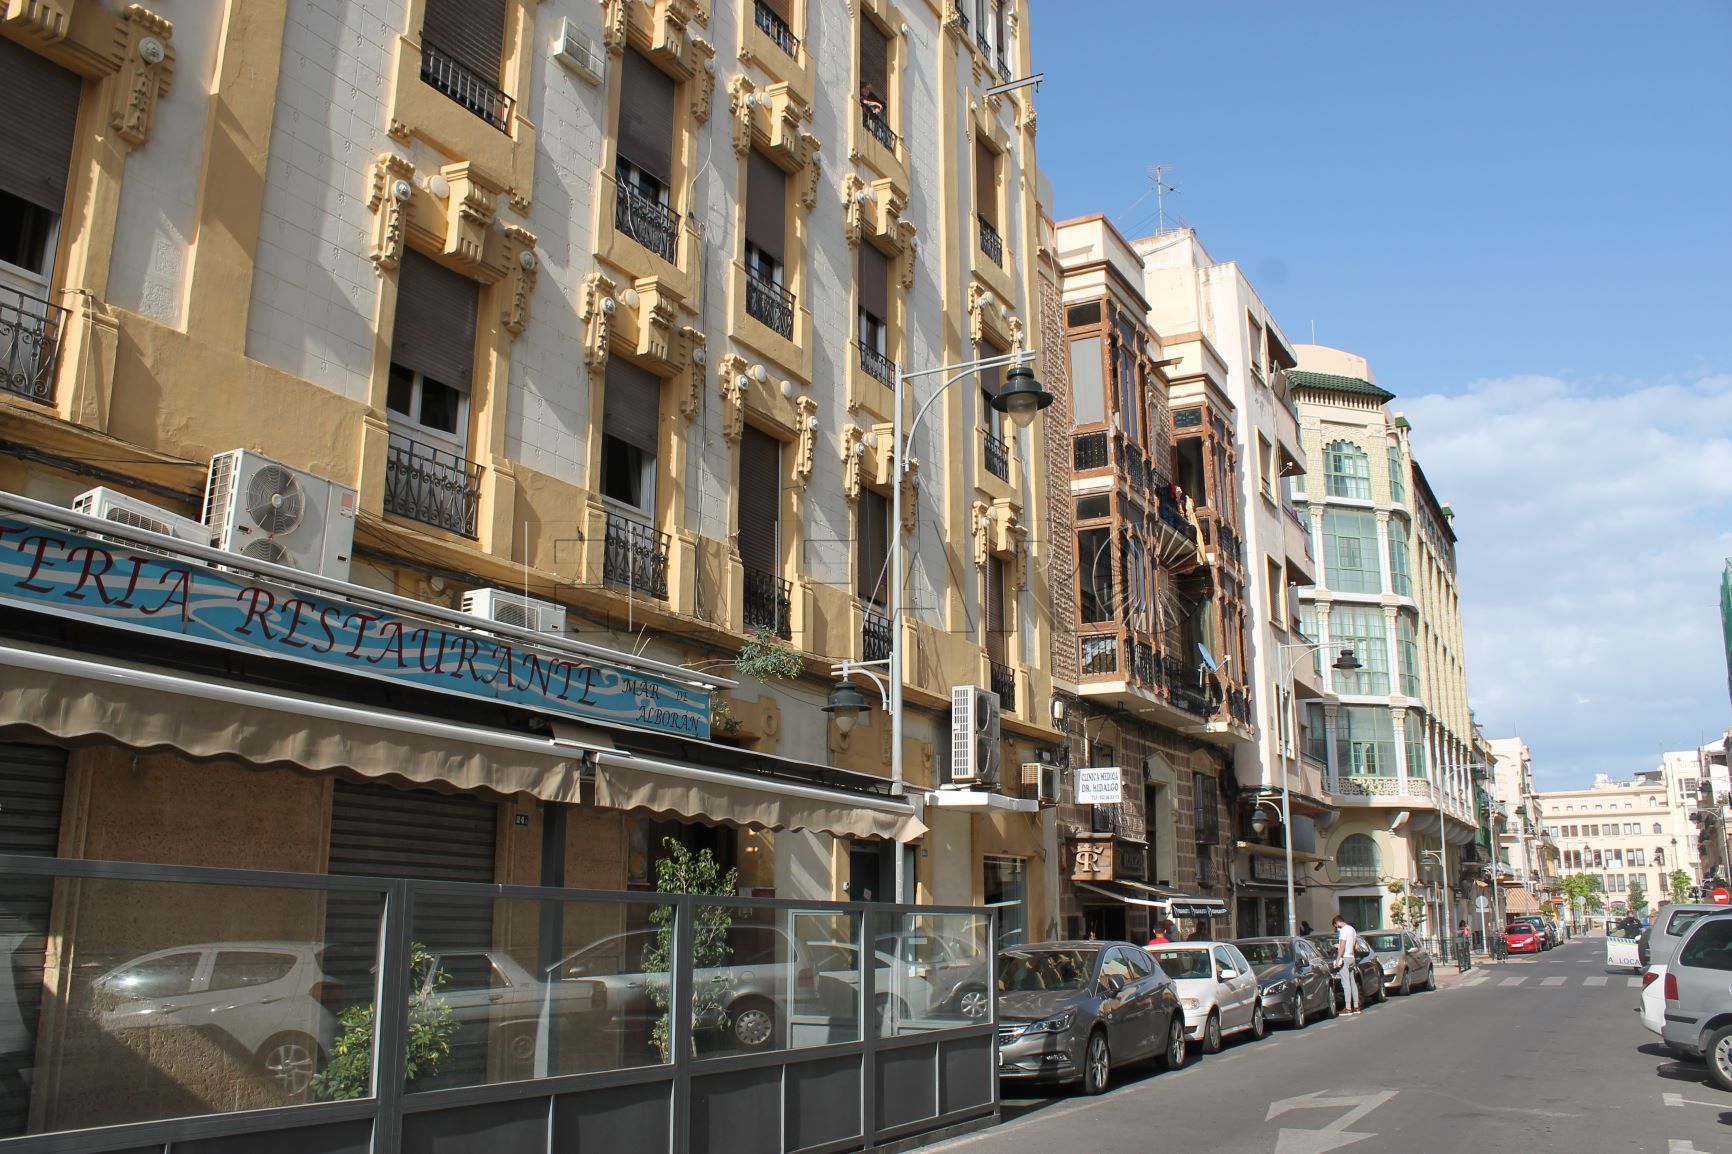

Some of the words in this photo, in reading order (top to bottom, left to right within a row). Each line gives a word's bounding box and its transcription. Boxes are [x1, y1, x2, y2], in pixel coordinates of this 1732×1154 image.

[234, 586, 601, 706] RESTAURANTE
[621, 679, 660, 700] MAR
[676, 691, 688, 702] DE
[636, 706, 700, 737] ALBORÁN
[1081, 783, 1092, 793] DR.
[1092, 783, 1119, 793] HIDALGO
